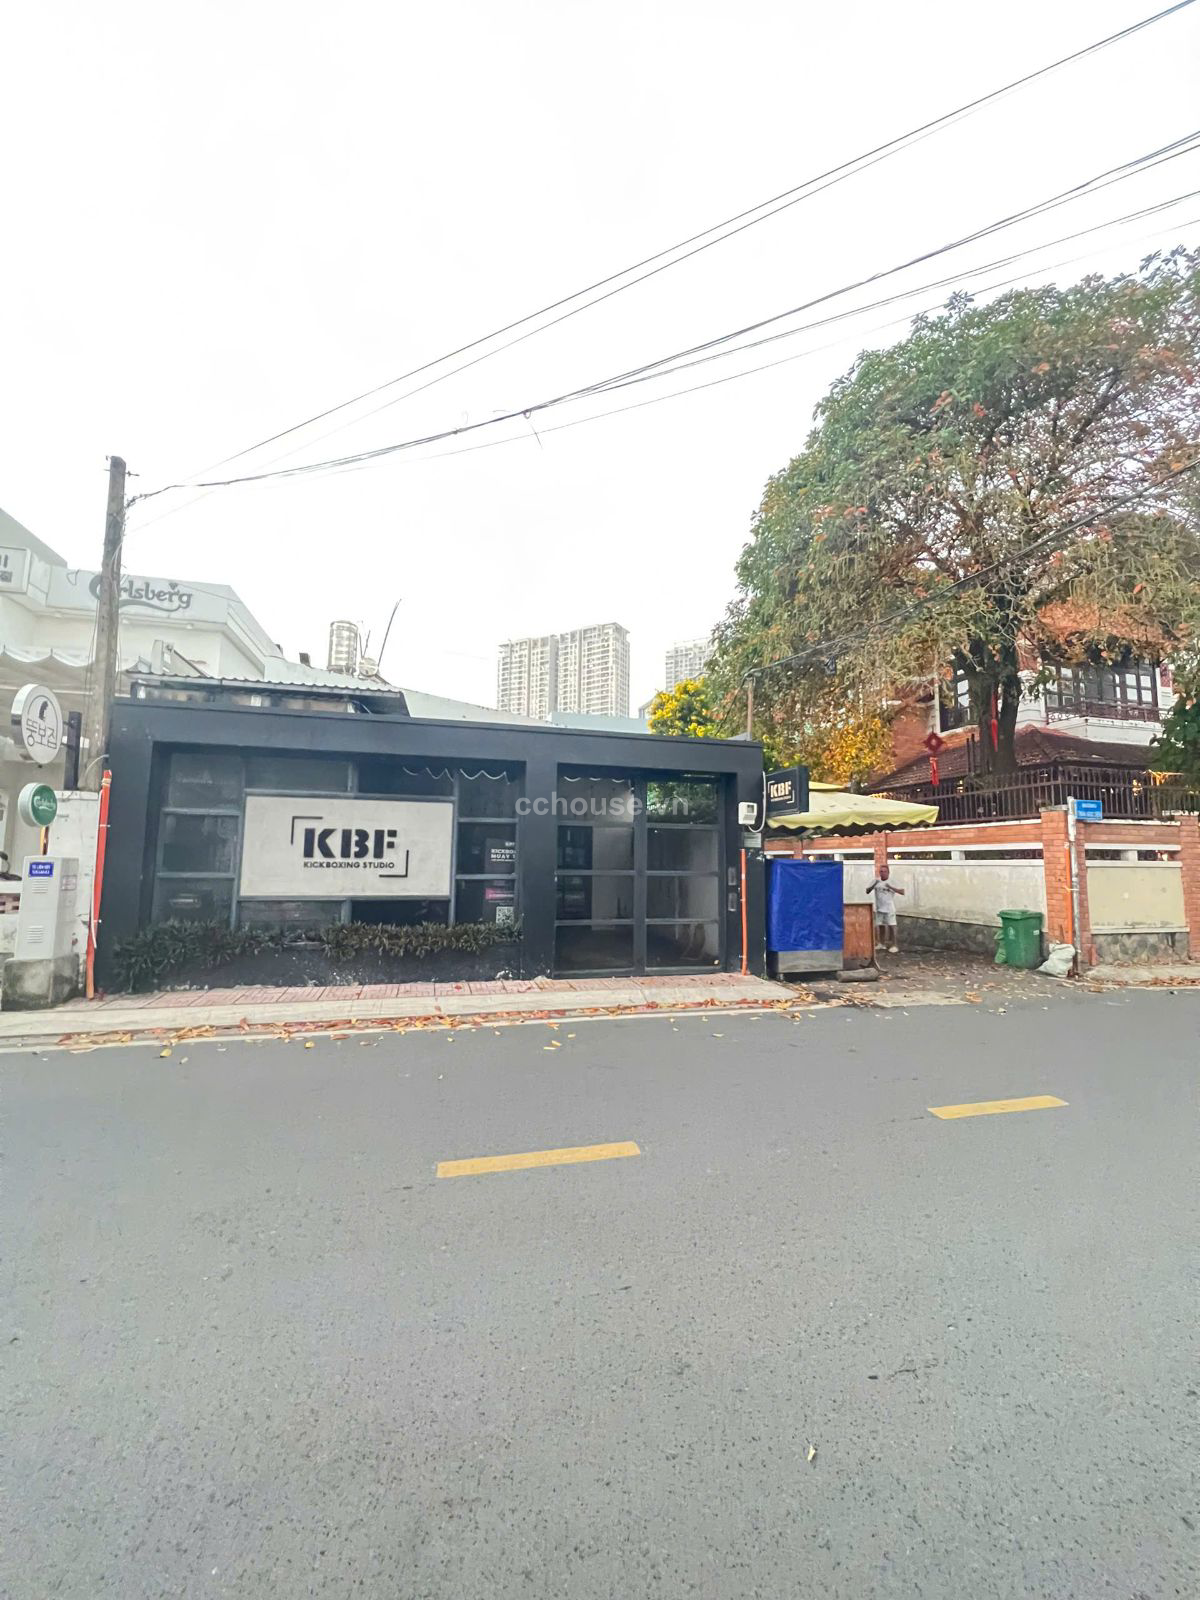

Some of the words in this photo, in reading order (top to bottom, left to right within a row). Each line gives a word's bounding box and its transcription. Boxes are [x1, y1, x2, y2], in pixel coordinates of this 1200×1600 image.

[770, 781, 791, 798] KBF
[303, 828, 397, 859] KBF
[303, 861, 360, 869] KICKBOXING
[362, 861, 395, 869] STUDIO
